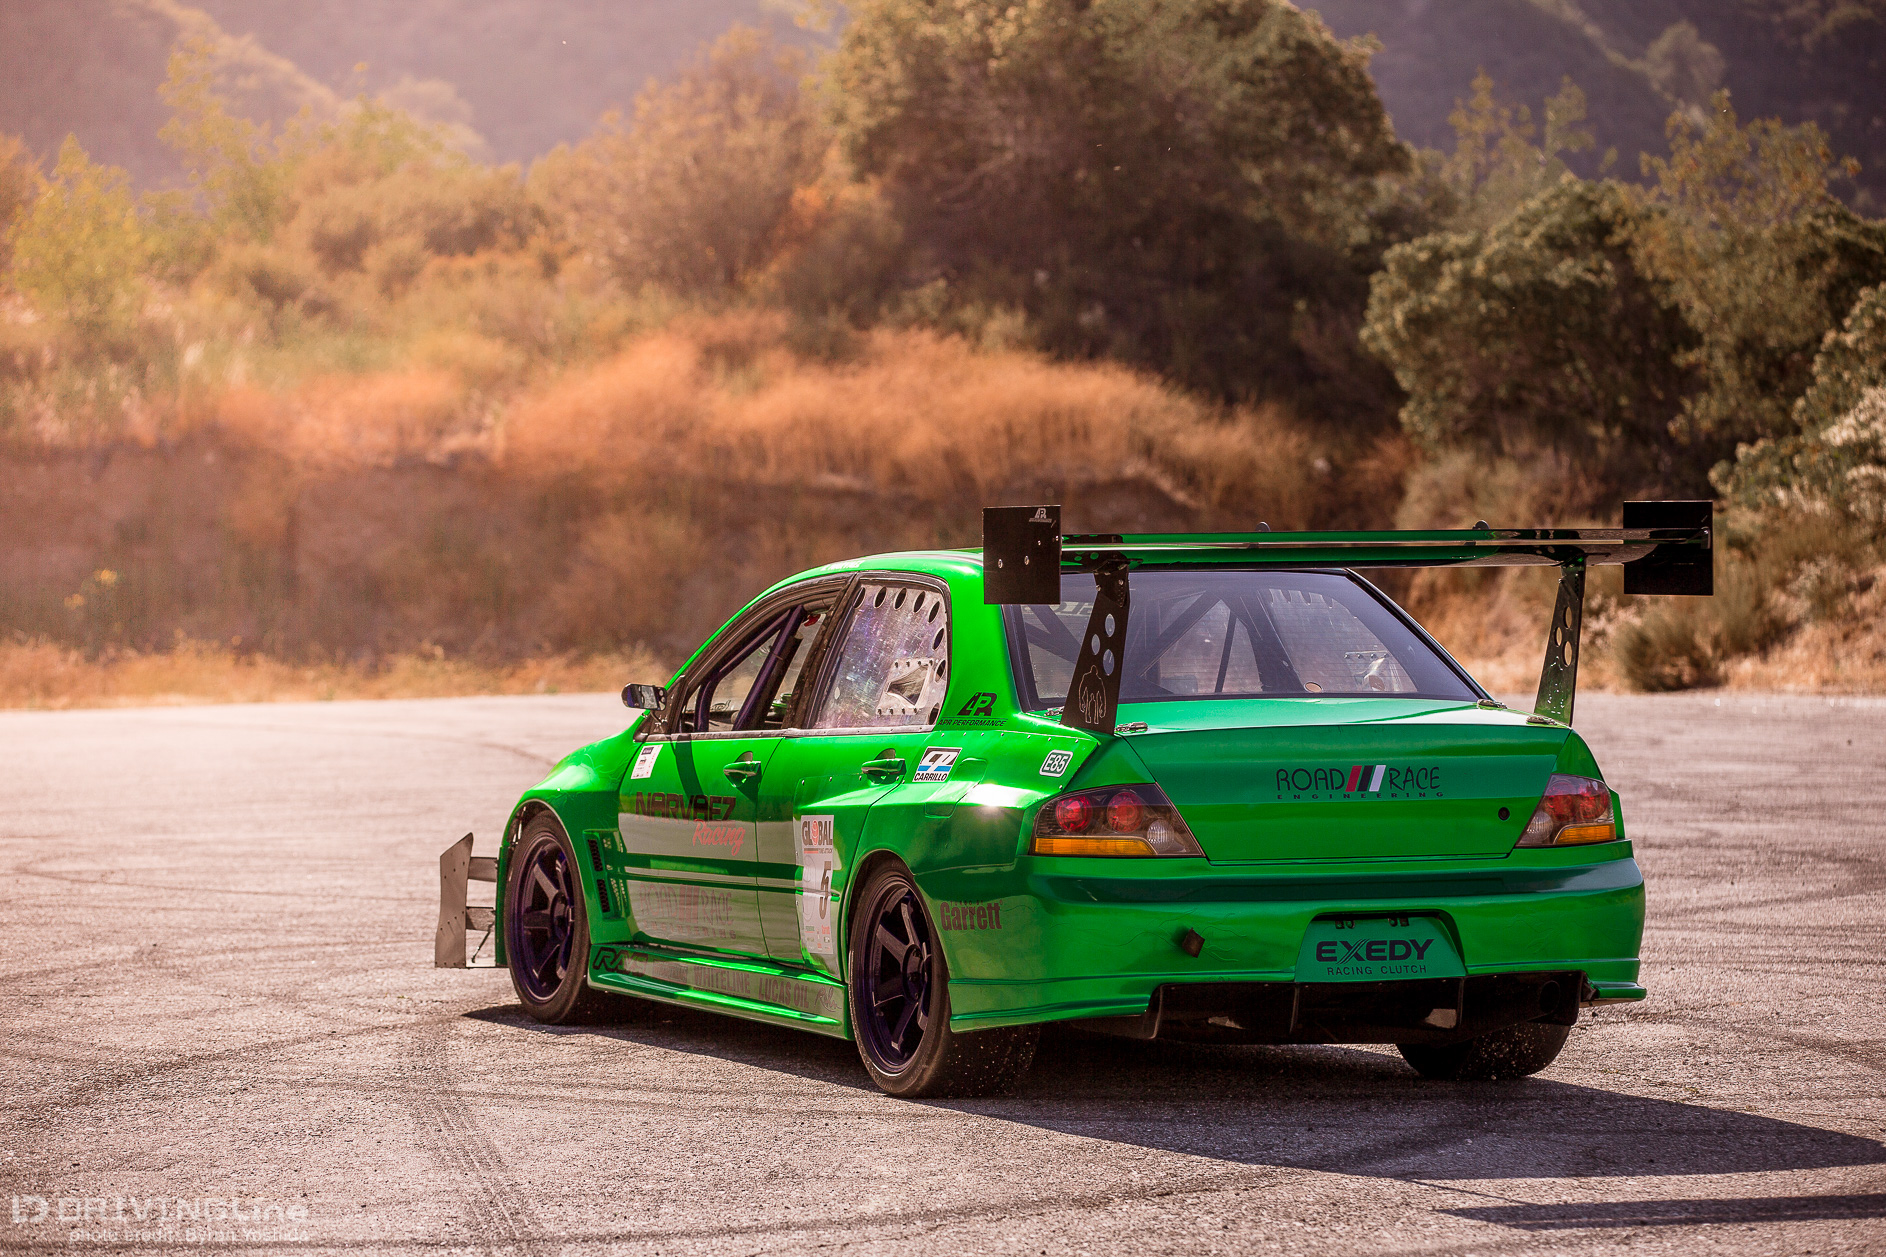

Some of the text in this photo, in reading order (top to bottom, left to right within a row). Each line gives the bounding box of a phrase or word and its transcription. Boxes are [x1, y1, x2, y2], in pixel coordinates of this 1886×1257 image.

[953, 719, 1007, 727] PERFORMANCE
[1043, 754, 1067, 773] E85
[913, 773, 948, 781] CARRILLO
[1276, 766, 1440, 791] ROAD RACE
[1277, 792, 1443, 800] ENGINEERING
[636, 791, 736, 828] NARVAEZ
[692, 819, 746, 856] Racing
[701, 889, 734, 926] RACE
[940, 901, 1003, 931] Garrett
[1316, 938, 1435, 964] EXEDY
[693, 965, 751, 994] WHITELINE
[1327, 965, 1427, 976] RACING CLUTCH
[759, 978, 792, 1006] LUCAS
[793, 983, 810, 1009] OIL
